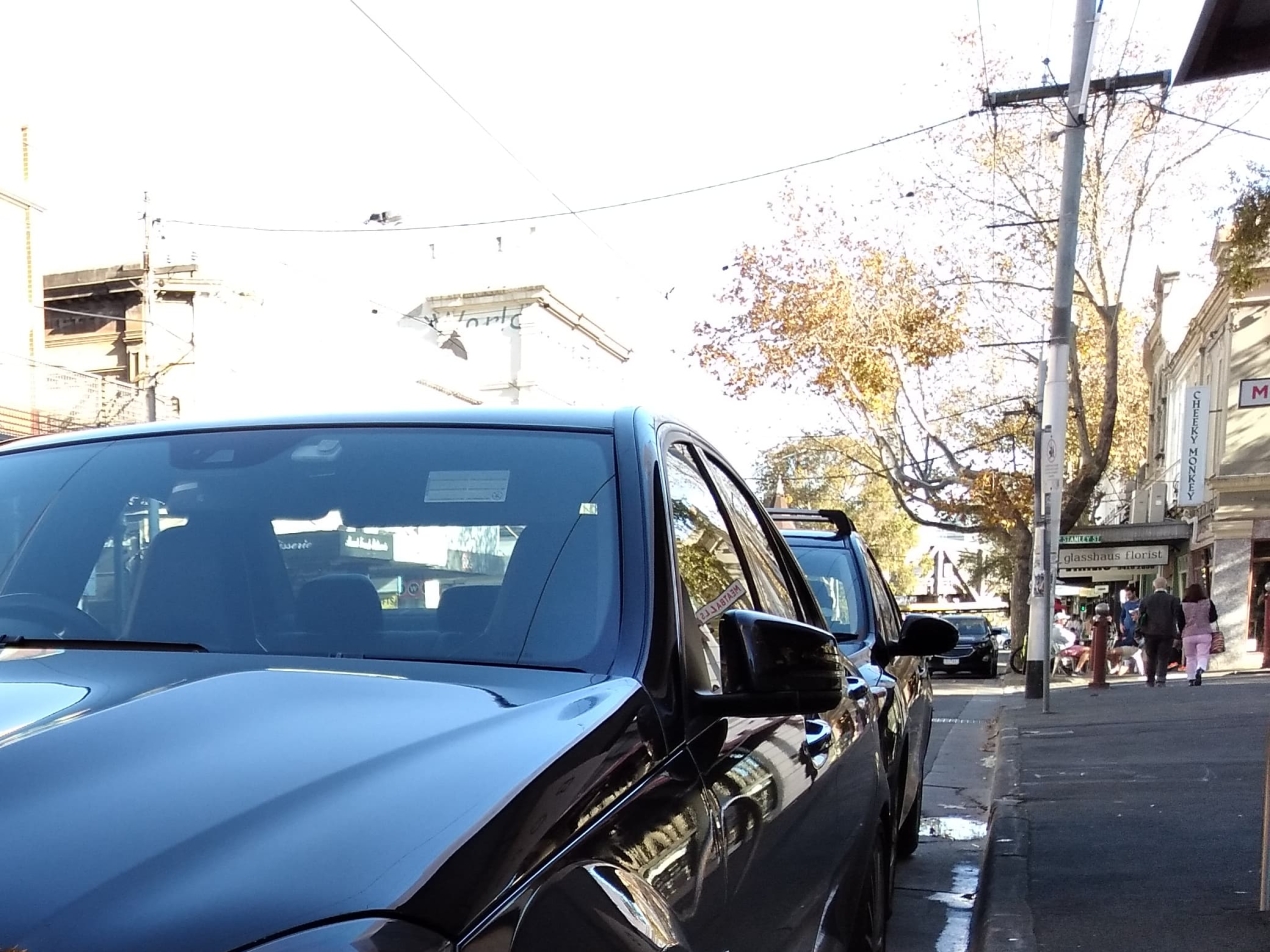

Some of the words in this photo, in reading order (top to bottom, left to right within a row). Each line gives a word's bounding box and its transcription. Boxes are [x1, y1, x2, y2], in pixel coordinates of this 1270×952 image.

[1190, 391, 1201, 444] CHEEKY
[1187, 448, 1198, 501] MONKEY
[1064, 552, 1121, 564] glasshaus
[1125, 550, 1163, 560] florist
